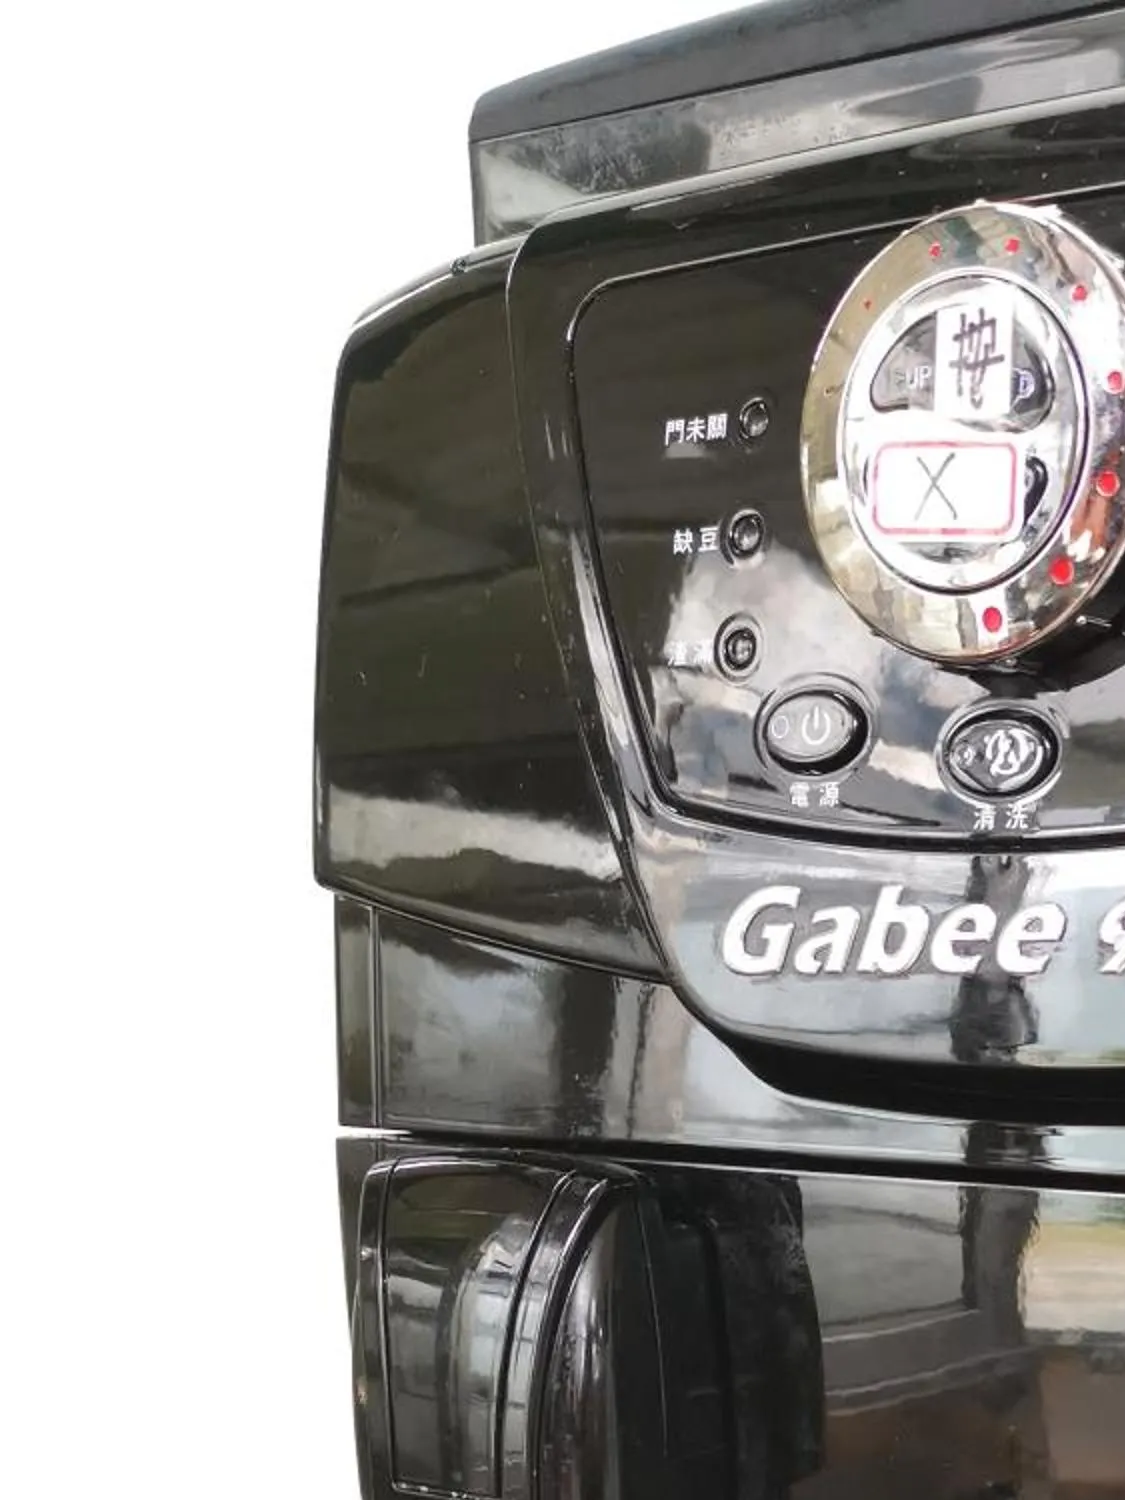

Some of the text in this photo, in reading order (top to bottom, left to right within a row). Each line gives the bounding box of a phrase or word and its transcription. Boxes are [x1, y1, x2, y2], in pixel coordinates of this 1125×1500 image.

[664, 413, 728, 446] 門未關
[672, 526, 719, 556] 缺豆
[788, 782, 840, 808] 電源
[972, 803, 1030, 831] 清洗
[721, 884, 1067, 978] Gabee
